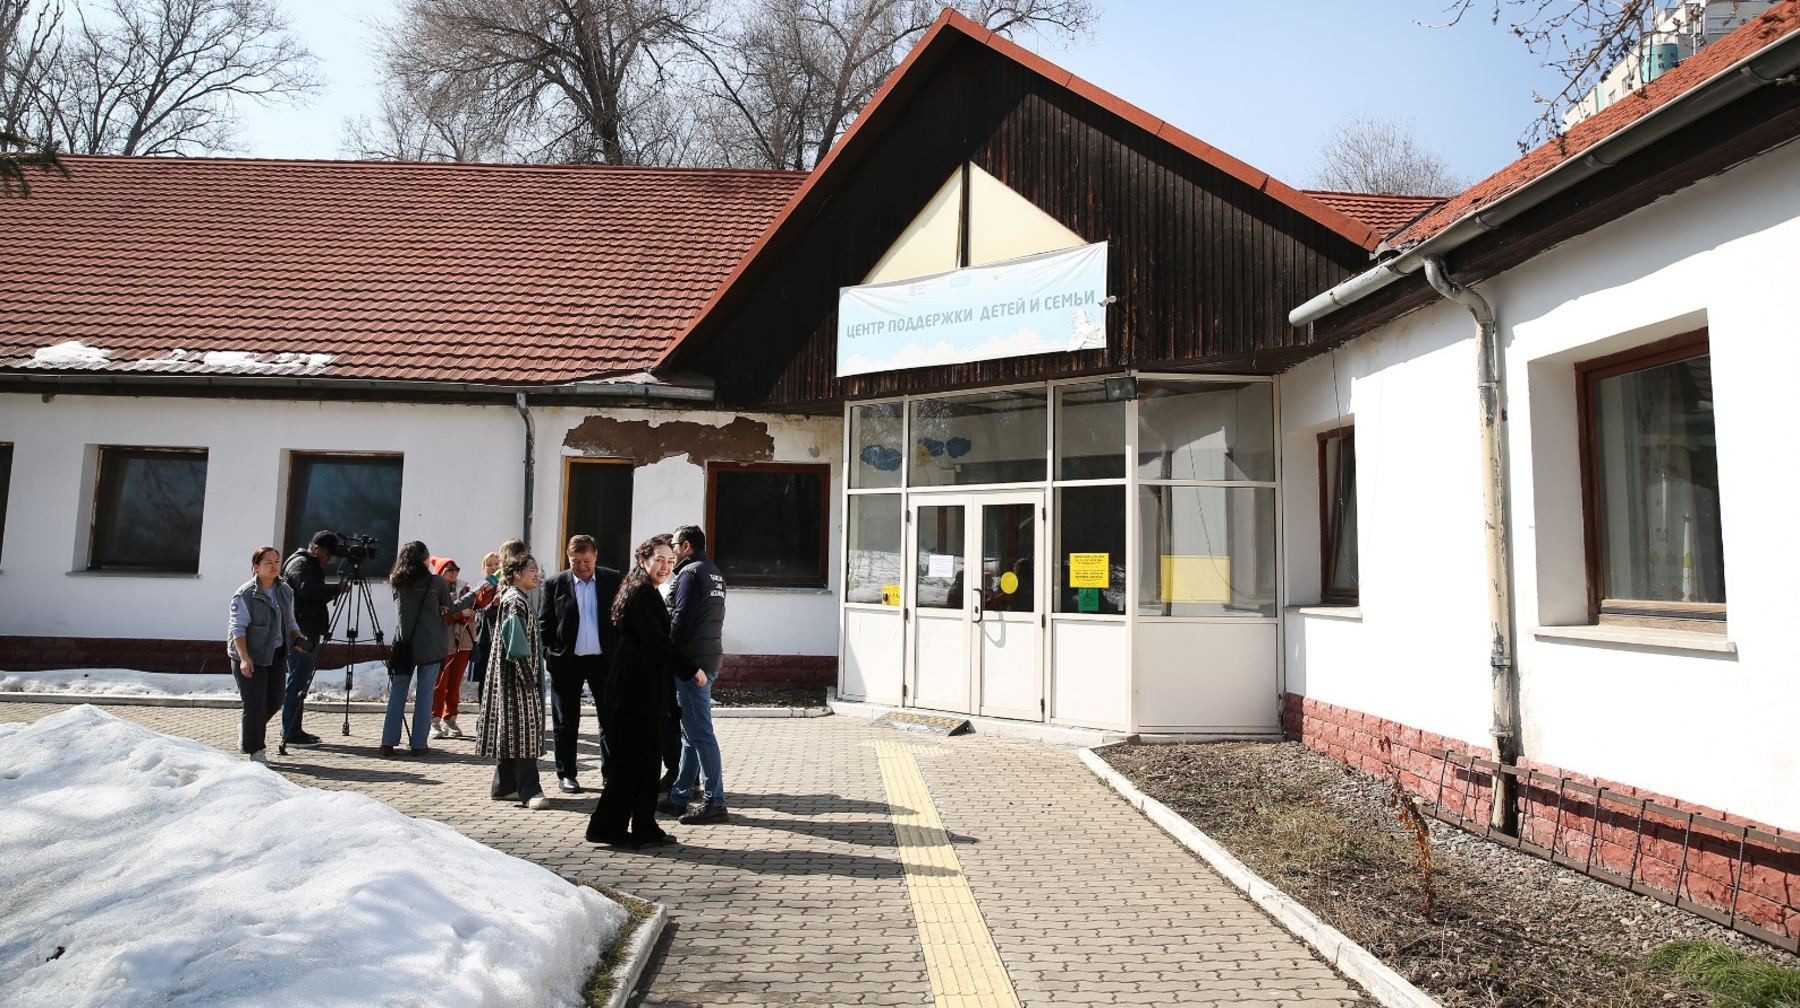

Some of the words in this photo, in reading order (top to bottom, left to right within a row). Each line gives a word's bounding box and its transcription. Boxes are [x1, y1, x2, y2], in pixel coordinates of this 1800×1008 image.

[846, 321, 885, 339] ЦЕНТР
[888, 308, 972, 332] ПОДДЕРЖКИ
[980, 297, 1026, 322] ДЕТЕЙ
[1030, 298, 1040, 313] И
[1044, 289, 1095, 310] СЕМЬИ
